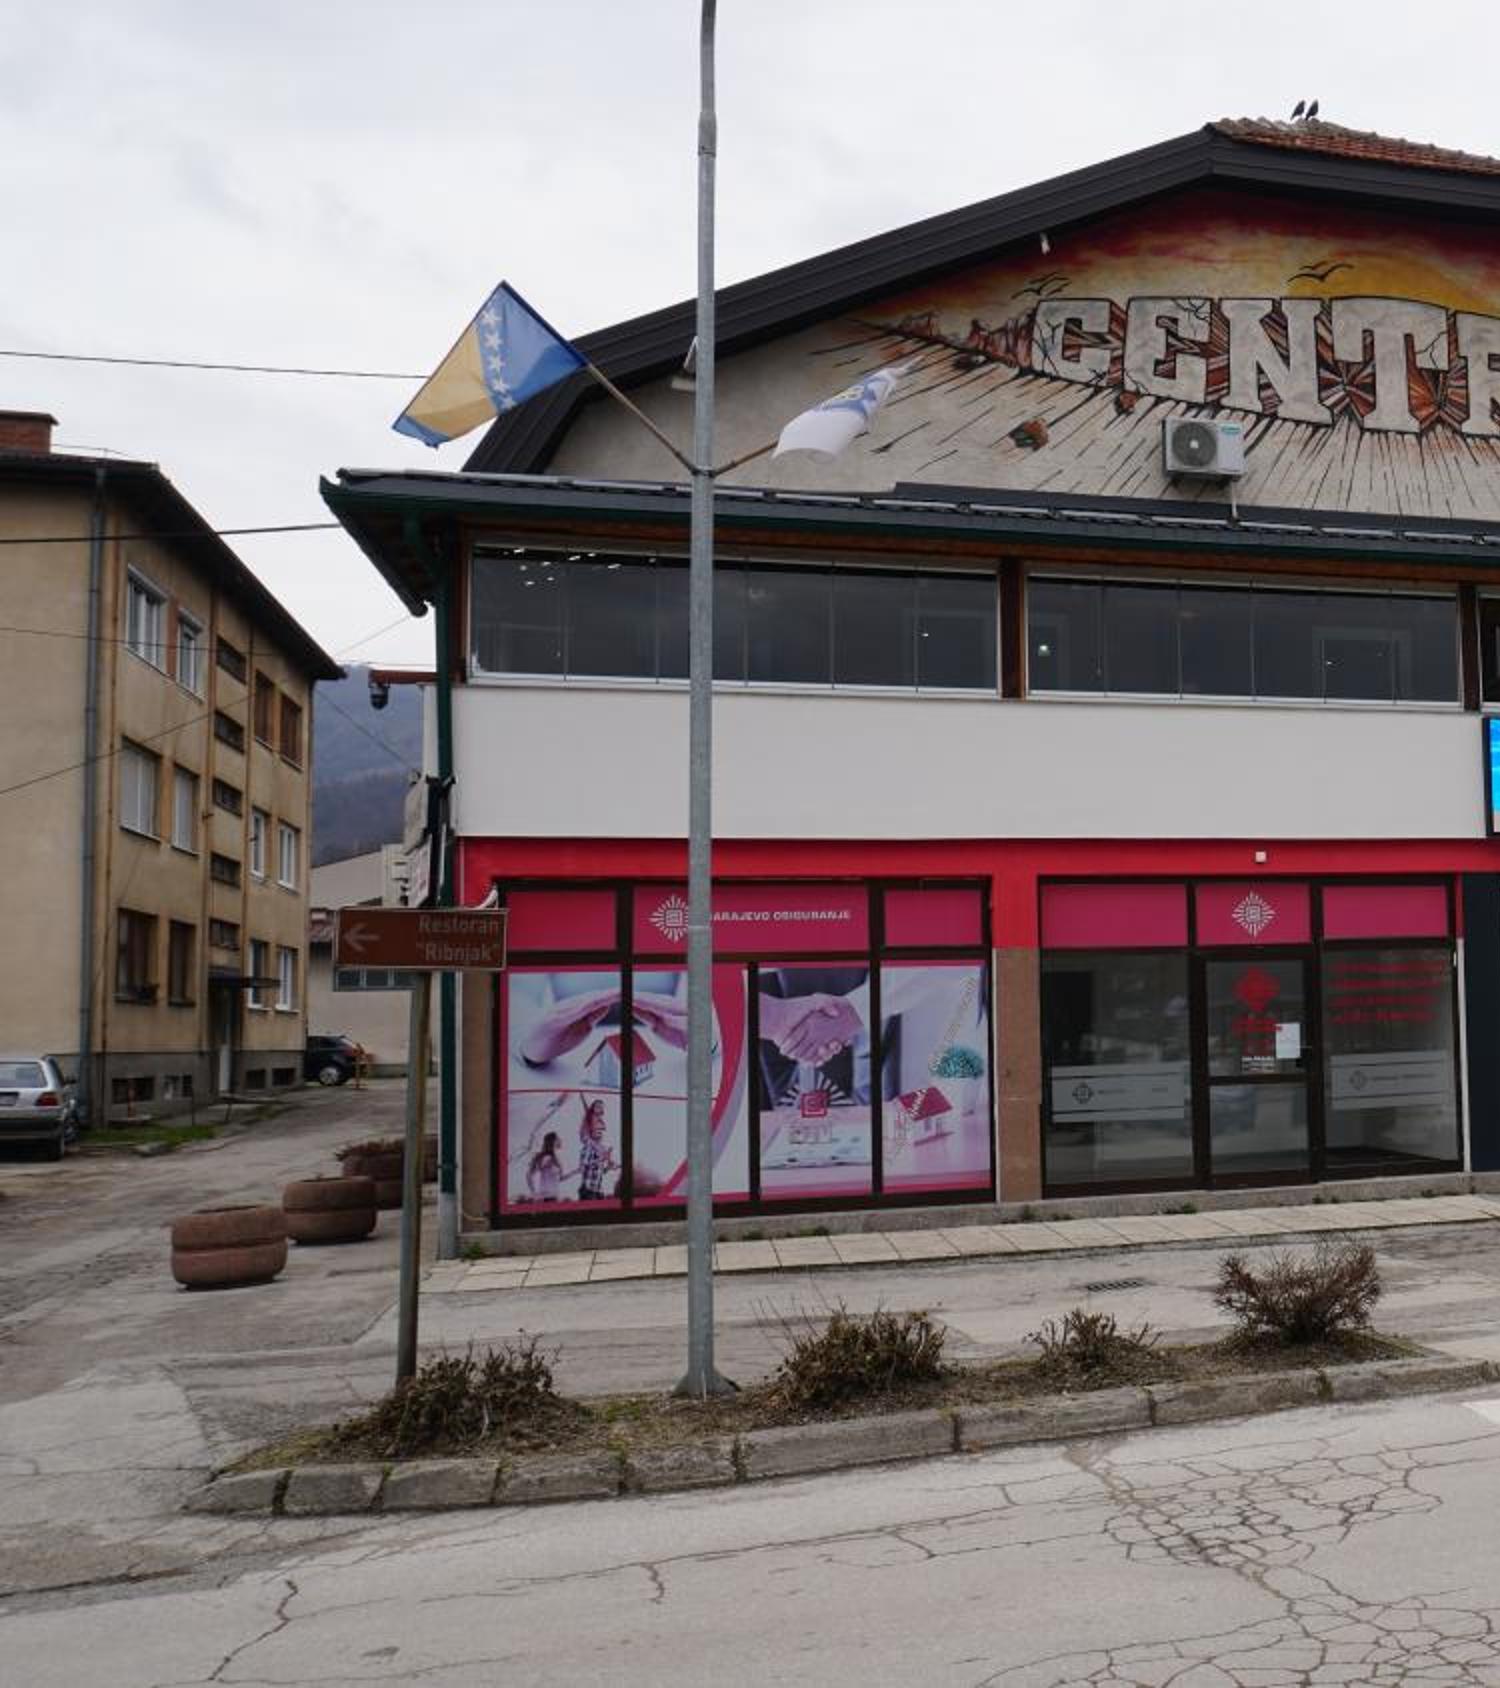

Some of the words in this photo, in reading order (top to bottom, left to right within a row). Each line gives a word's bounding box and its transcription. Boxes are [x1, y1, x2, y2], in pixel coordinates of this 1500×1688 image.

[418, 914, 500, 935] Restoran
[709, 911, 769, 922] ARAJEVO
[416, 942, 500, 965] "Ribnjak"
